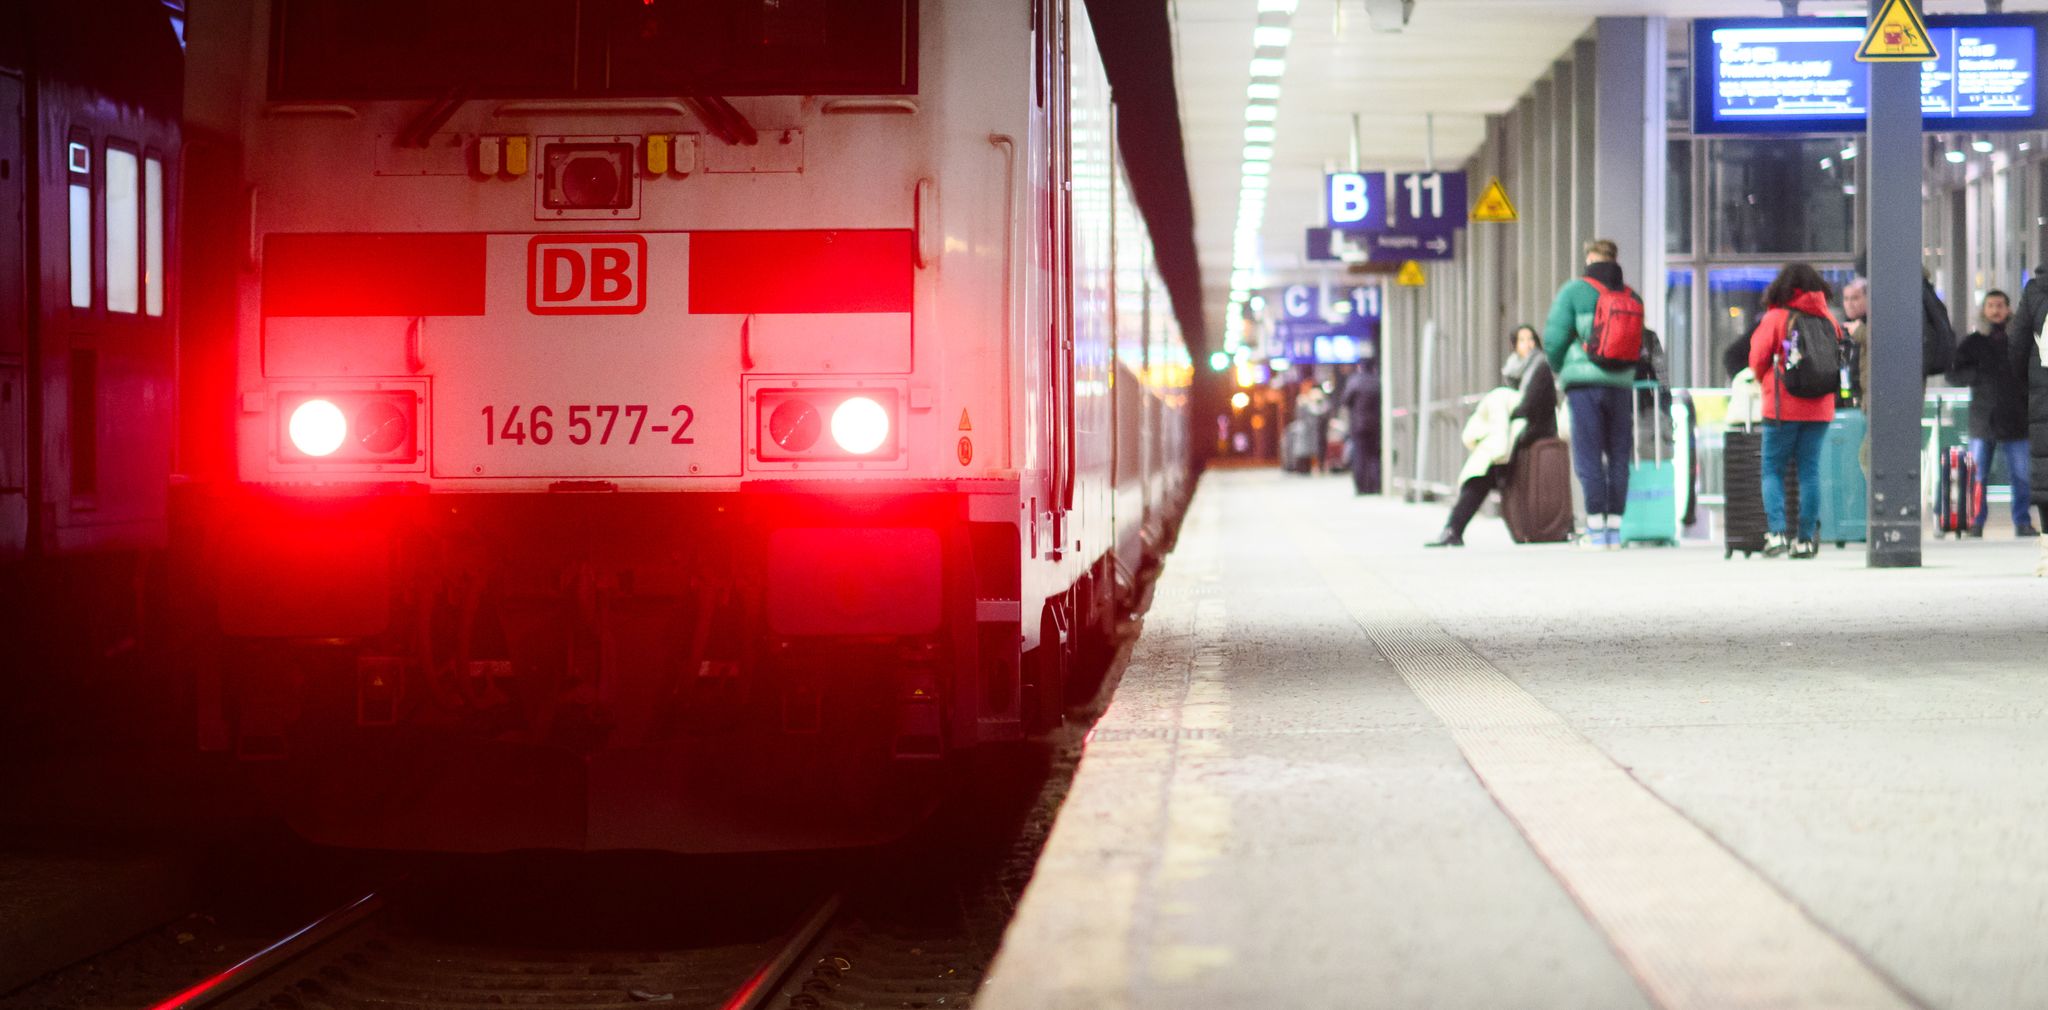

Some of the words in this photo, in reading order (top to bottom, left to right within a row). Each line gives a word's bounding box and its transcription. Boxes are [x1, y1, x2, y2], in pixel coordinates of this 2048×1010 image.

[1331, 173, 1369, 222] B
[1404, 174, 1442, 218] 11
[543, 248, 633, 301] DB
[1285, 285, 1309, 317] C
[1352, 287, 1378, 316] 11
[482, 405, 553, 445] 146
[569, 405, 694, 445] 577-2
